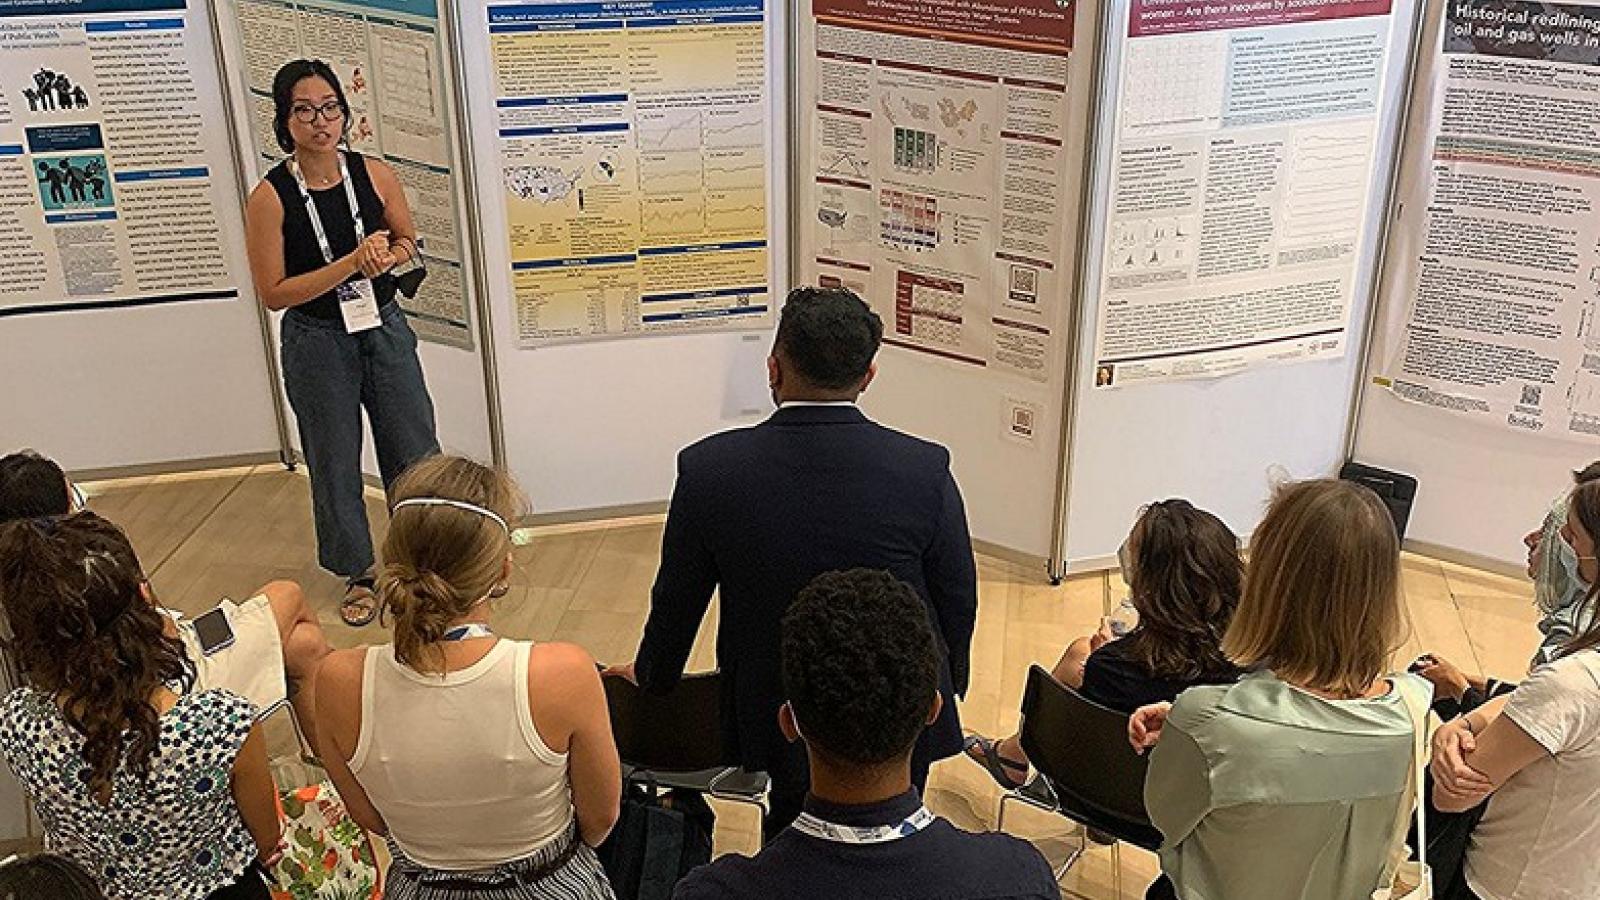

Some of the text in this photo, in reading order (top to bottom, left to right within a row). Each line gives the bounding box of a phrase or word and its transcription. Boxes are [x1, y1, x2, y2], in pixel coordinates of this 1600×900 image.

[1141, 10, 1175, 20] women
[1185, 6, 1203, 16] Are
[1204, 4, 1228, 15] there
[1274, 1, 1285, 11] by
[1455, 4, 1600, 34] Historical redlining
[34, 30, 60, 39] Health
[1454, 22, 1599, 49] oil and gas wells in
